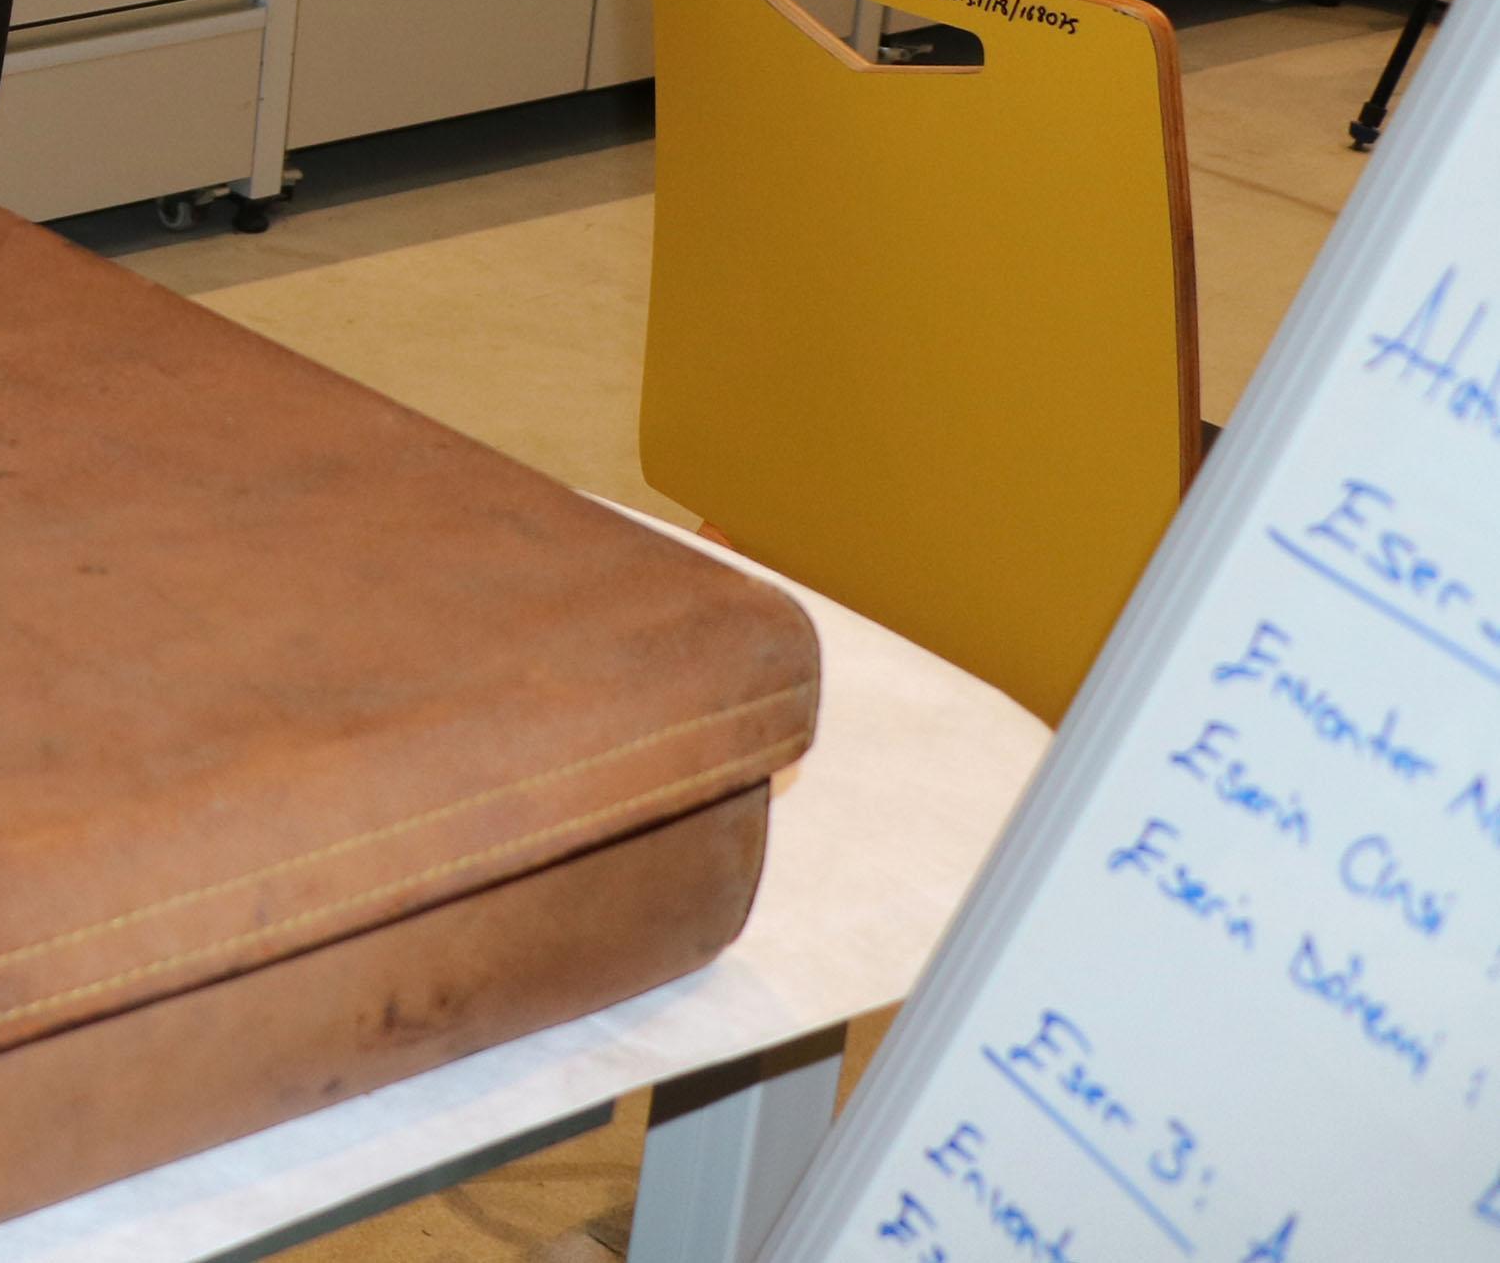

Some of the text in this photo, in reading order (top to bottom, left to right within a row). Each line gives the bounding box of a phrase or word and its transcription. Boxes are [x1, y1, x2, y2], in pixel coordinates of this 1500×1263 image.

[1167, 718, 1310, 847] Eserin
[1106, 816, 1256, 951] Eserin
[1007, 1007, 1136, 1132] Eser
